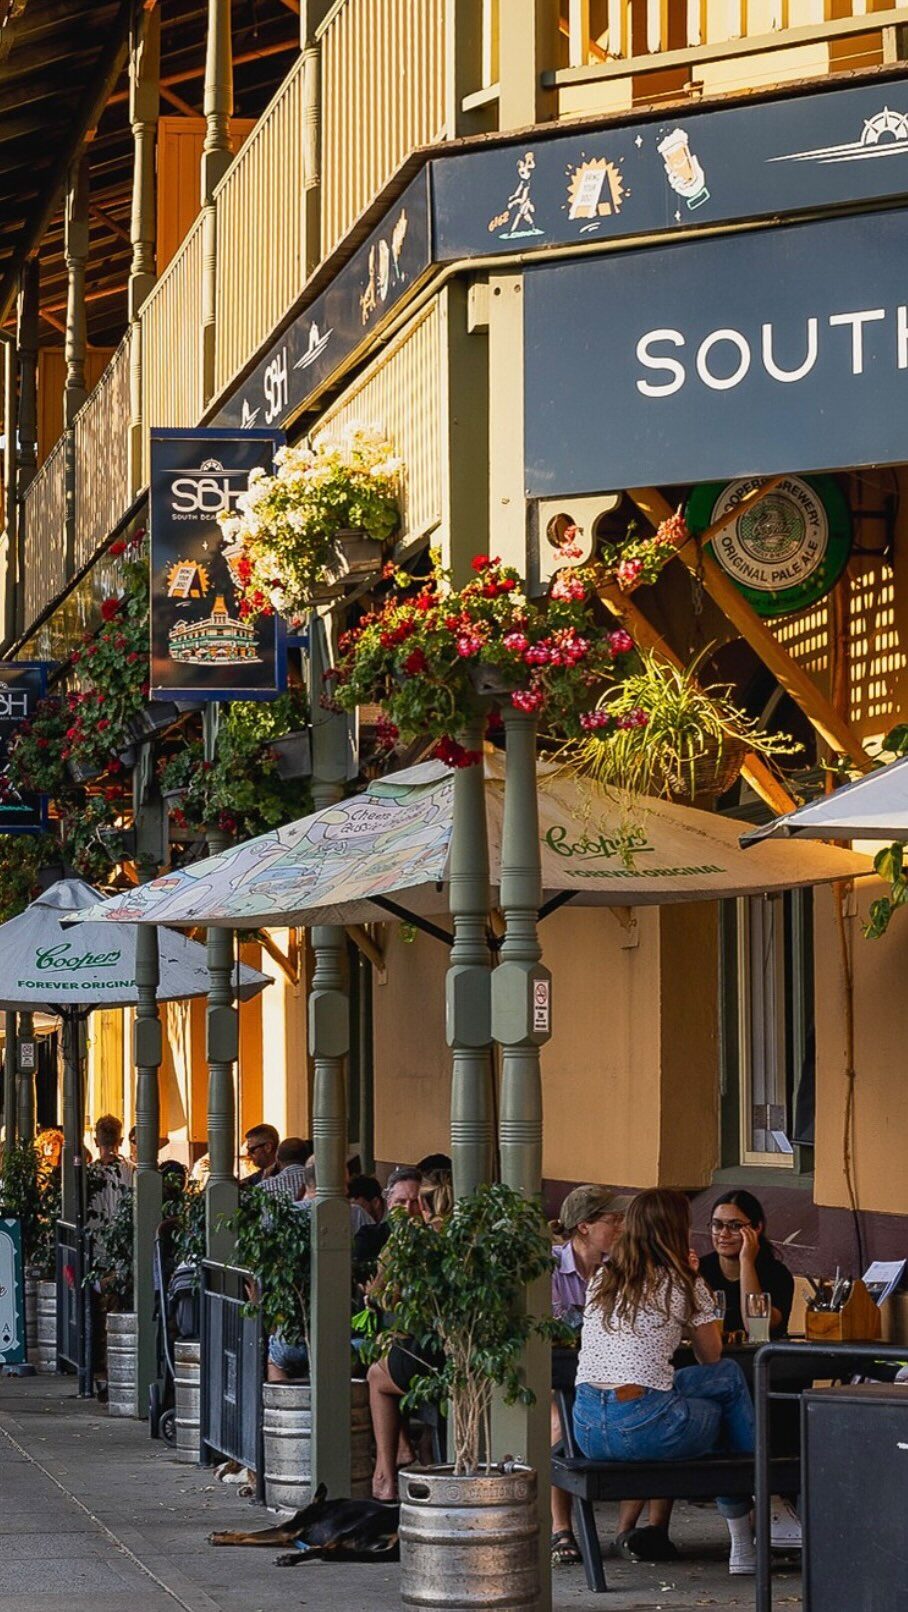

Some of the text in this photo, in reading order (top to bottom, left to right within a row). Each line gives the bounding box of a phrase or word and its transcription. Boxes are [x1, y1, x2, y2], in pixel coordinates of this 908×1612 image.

[635, 306, 908, 397] SOUT
[264, 346, 288, 424] SBH
[171, 478, 252, 512] SBH
[724, 478, 820, 527] OOPER REWERY
[721, 536, 768, 582] ORIGINAL
[771, 560, 802, 582] PALE
[803, 540, 818, 567] ALE
[0, 693, 28, 716] BH
[563, 864, 728, 878] FOREVER ORIGINAL
[36, 942, 121, 973] Coopers
[18, 980, 137, 989] FOREVER ORIGINA
